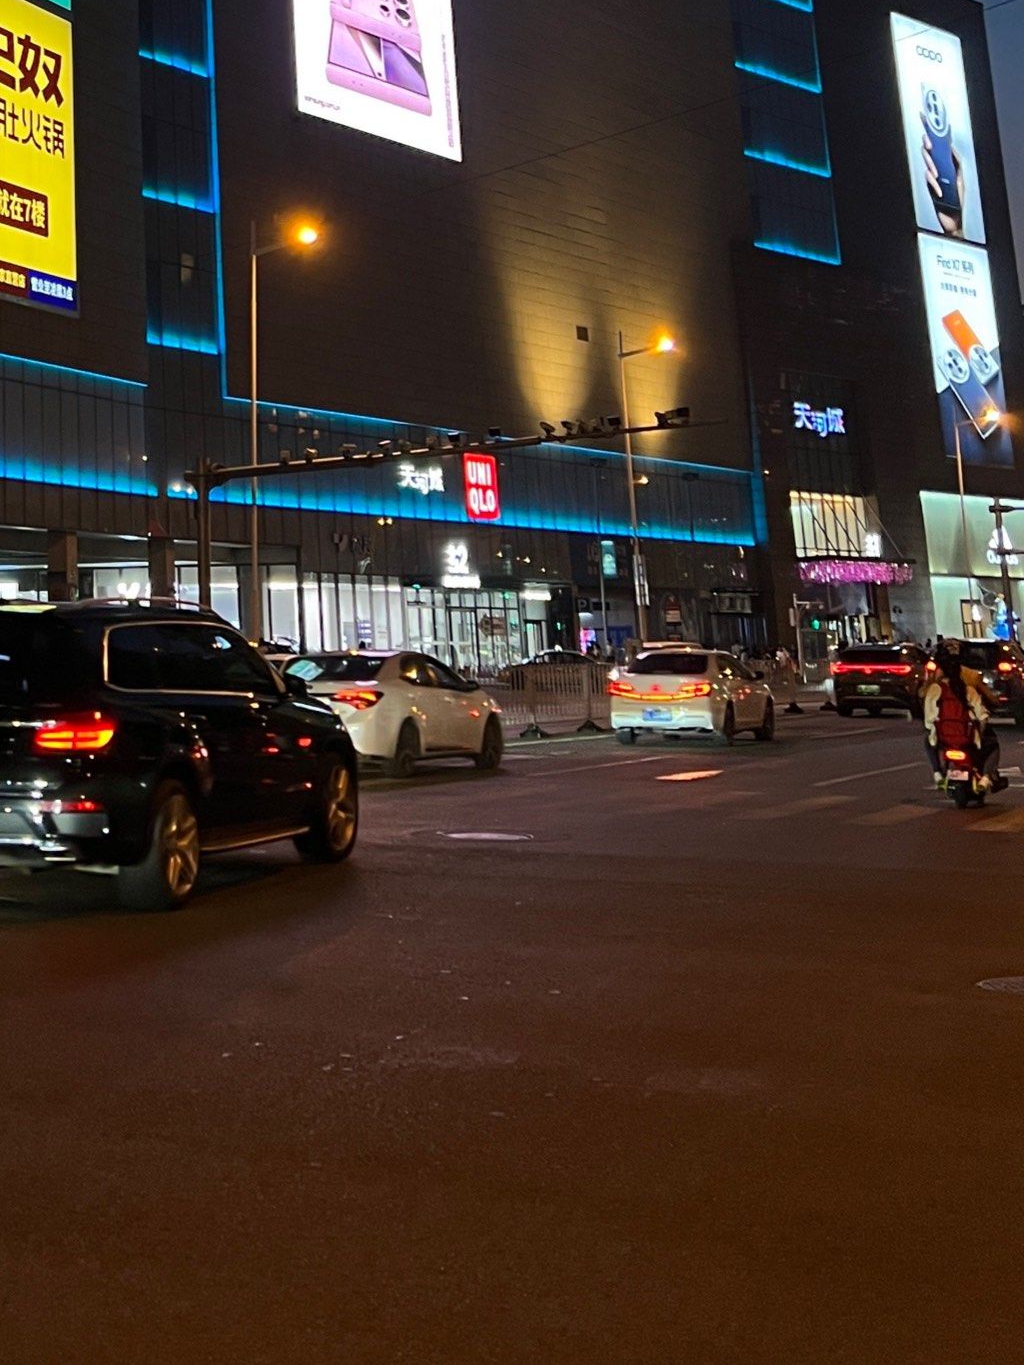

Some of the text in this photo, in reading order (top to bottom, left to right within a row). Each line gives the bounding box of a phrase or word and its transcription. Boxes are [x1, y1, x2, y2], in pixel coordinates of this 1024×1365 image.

[793, 401, 846, 438] 天河城
[466, 461, 492, 487] UNI
[469, 488, 496, 516] QLO
